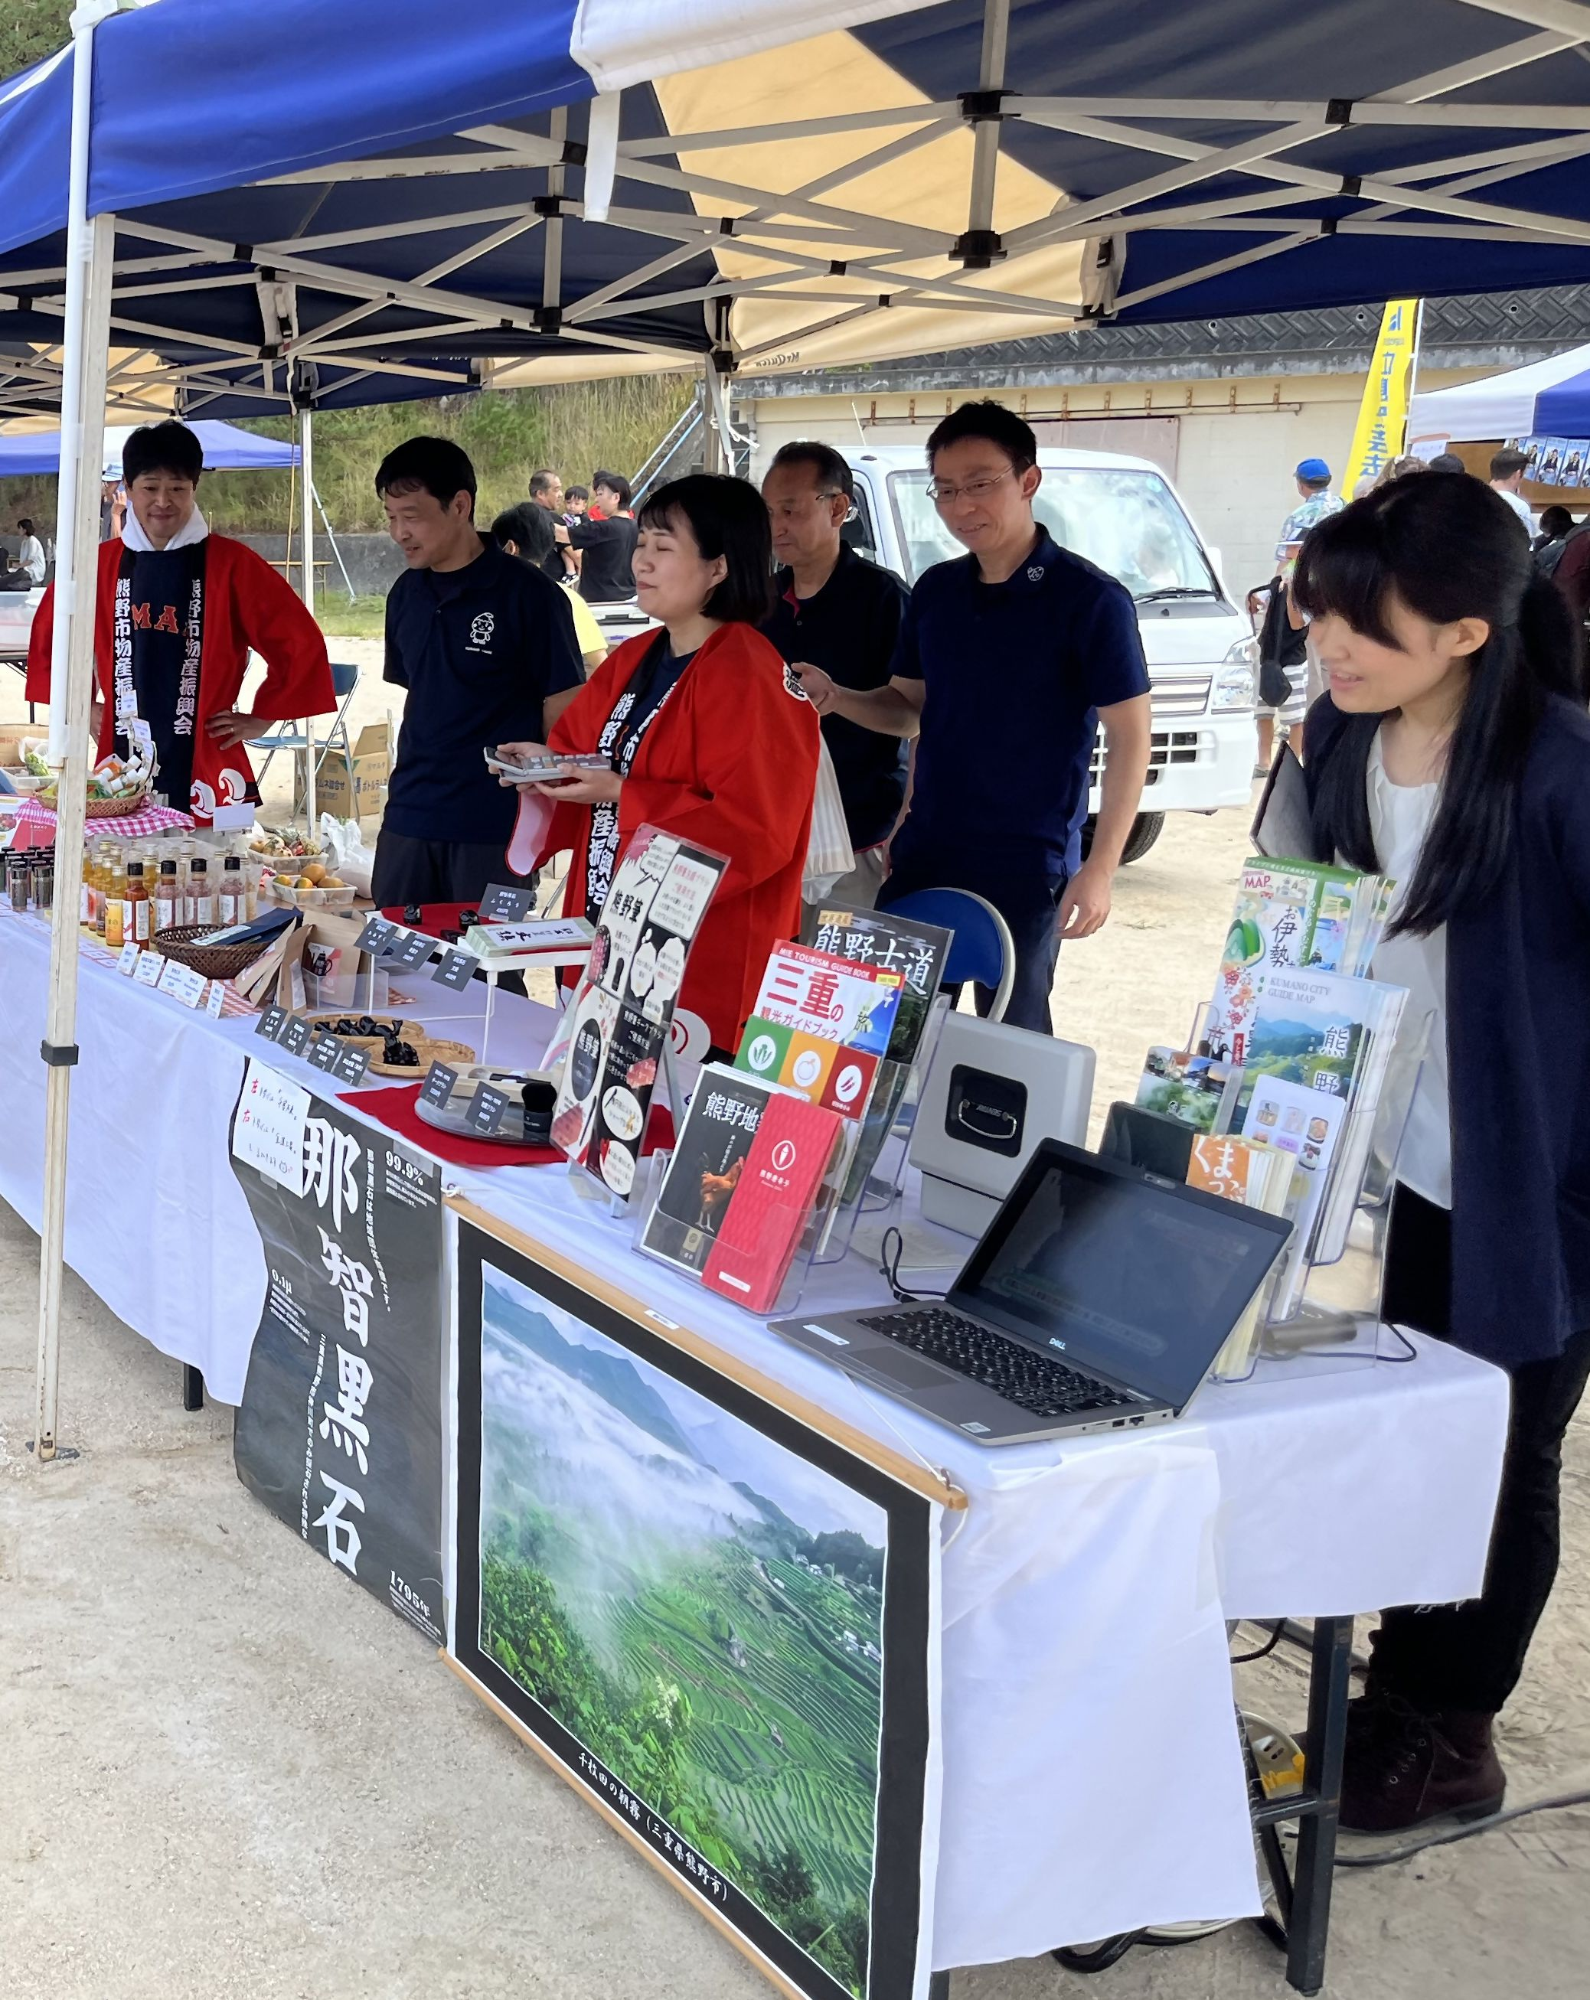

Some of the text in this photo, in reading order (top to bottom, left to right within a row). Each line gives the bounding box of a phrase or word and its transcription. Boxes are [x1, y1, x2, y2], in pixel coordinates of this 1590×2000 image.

[131, 602, 187, 636] MA
[1244, 875, 1271, 889] MAP
[778, 948, 793, 958] MIE
[794, 951, 830, 969] TOURISM
[830, 962, 854, 975] GUIDE
[766, 962, 844, 1023] 三重の
[1267, 987, 1316, 1004] GUIDE MAP
[1270, 976, 1332, 996] KUMANO CITY
[760, 1005, 839, 1041] 観光ガイドブック
[702, 1090, 764, 1135] 熊野地
[385, 1150, 424, 1186] 99.9%
[1194, 1135, 1234, 1179] くま
[303, 1118, 375, 1577] 那智黒石
[1048, 1336, 1067, 1350] DELL
[389, 1569, 431, 1618] 1795年
